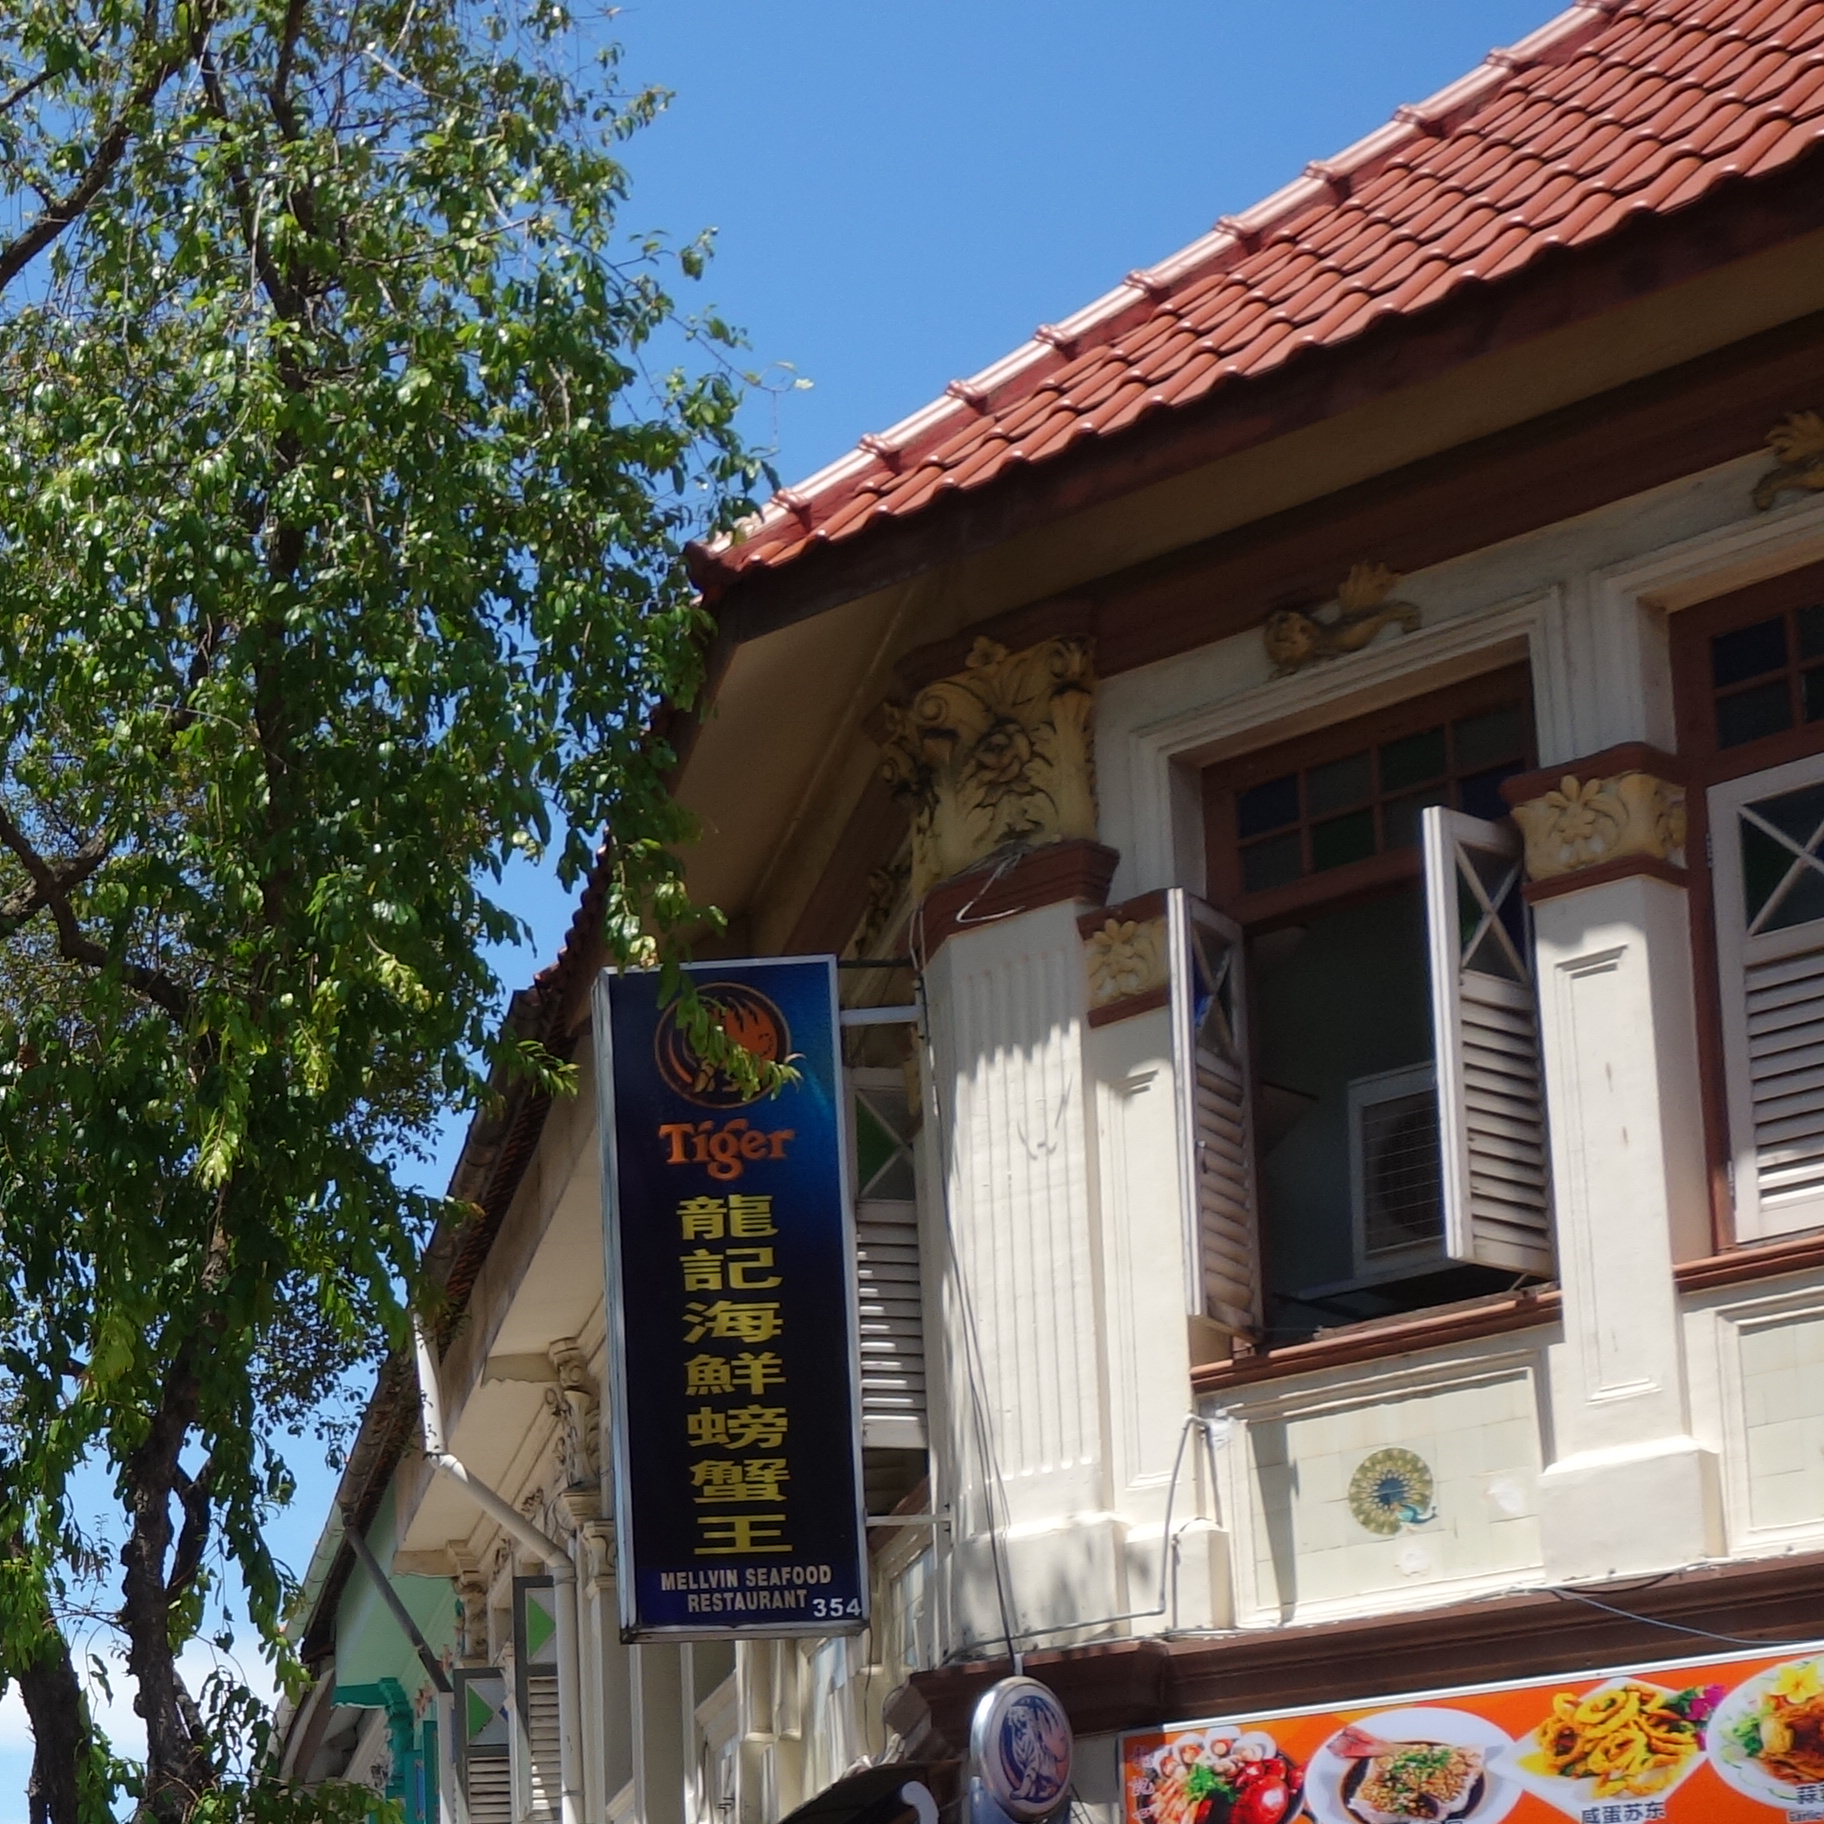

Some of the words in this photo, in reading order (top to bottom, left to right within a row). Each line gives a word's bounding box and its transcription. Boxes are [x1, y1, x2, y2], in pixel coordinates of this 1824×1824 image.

[658, 1117, 796, 1183] Tiger
[675, 1193, 793, 1556] 龍記海鮮螃蟹王
[661, 1569, 738, 1591] MELLVIN
[744, 1564, 832, 1588] SEAFOOD
[687, 1588, 807, 1613] RESTAURANT
[812, 1597, 862, 1619] 354
